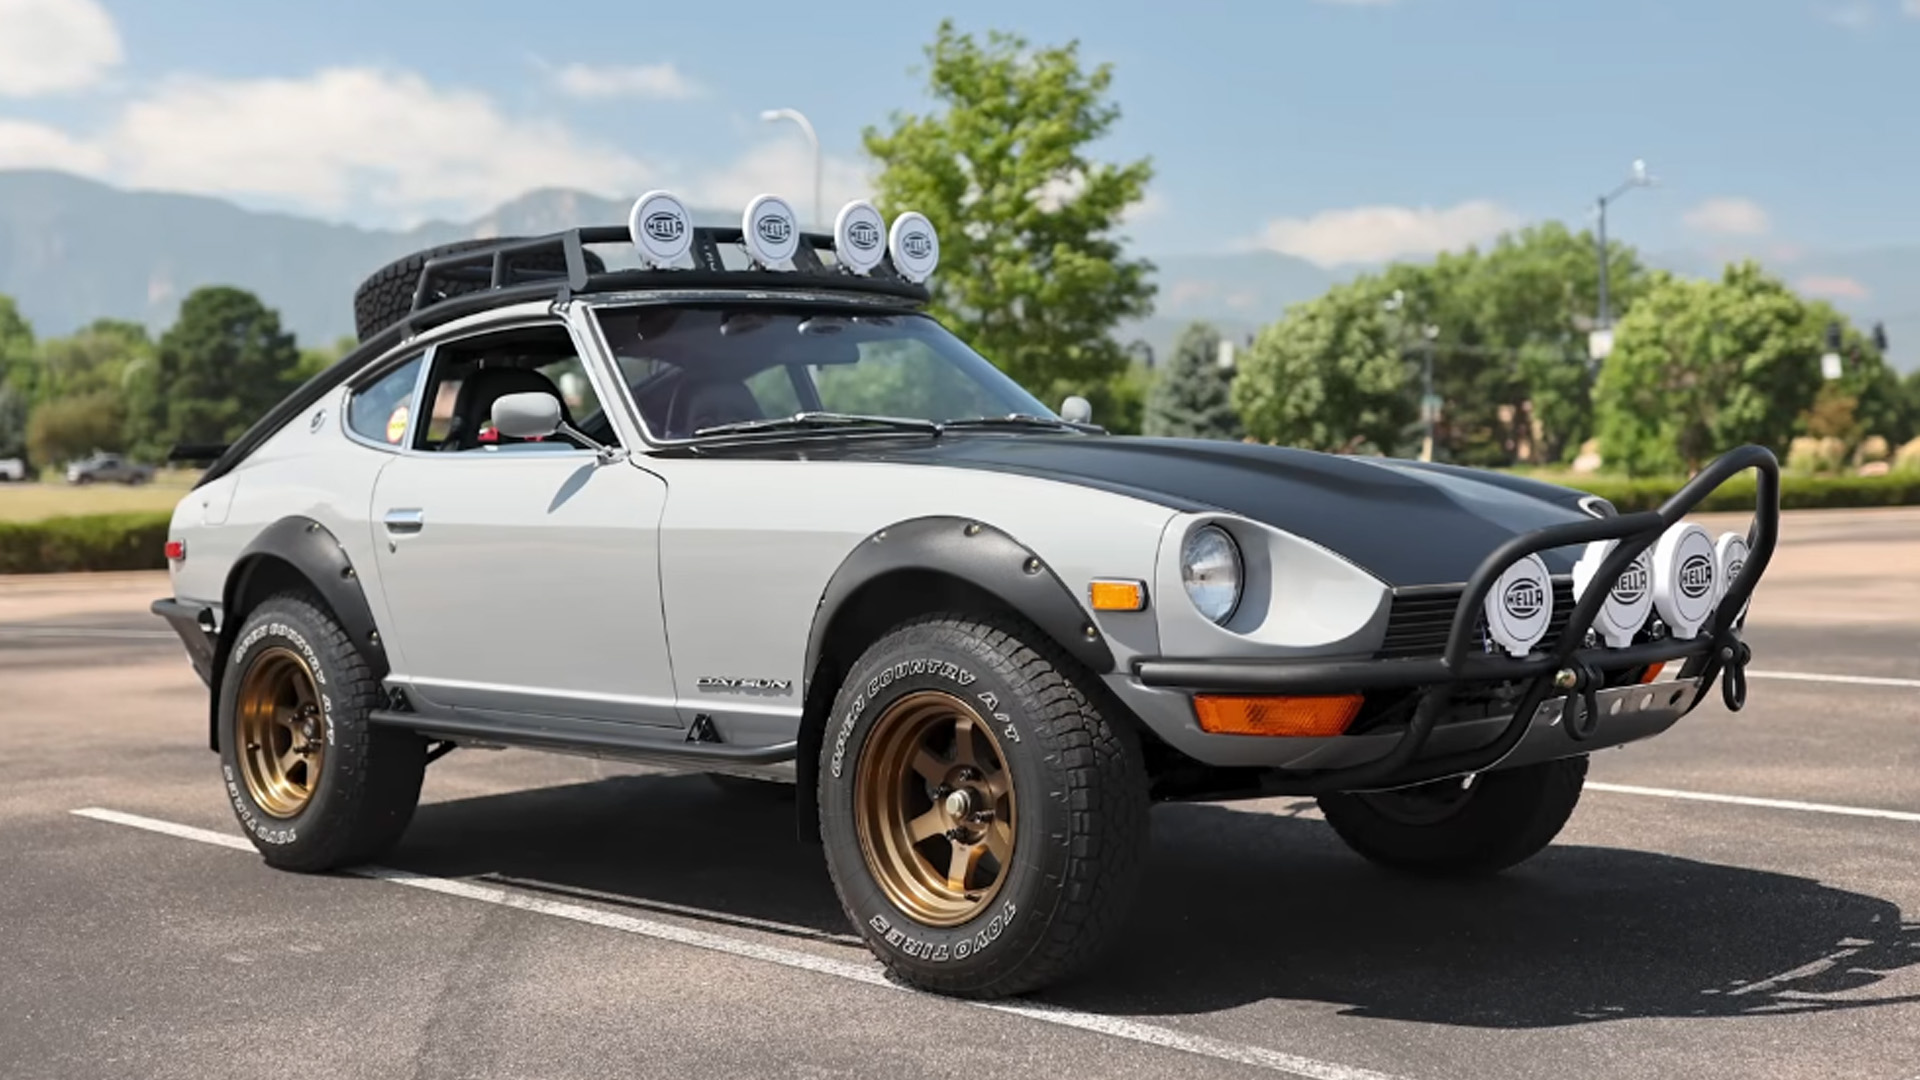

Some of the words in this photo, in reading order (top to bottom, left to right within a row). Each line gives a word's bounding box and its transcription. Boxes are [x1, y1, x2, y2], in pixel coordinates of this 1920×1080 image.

[647, 220, 684, 234] HELLA
[758, 222, 791, 236] HELLA
[849, 229, 879, 243] HELLA
[1681, 566, 1712, 584] HELLA
[1507, 589, 1543, 606] HELLA
[697, 677, 792, 690] DATSUN
[831, 695, 864, 778] OPEN
[867, 658, 977, 698] COUNTRY
[977, 691, 1021, 744] A/T
[868, 914, 950, 961] TIRES
[953, 900, 1017, 960] TOYO
